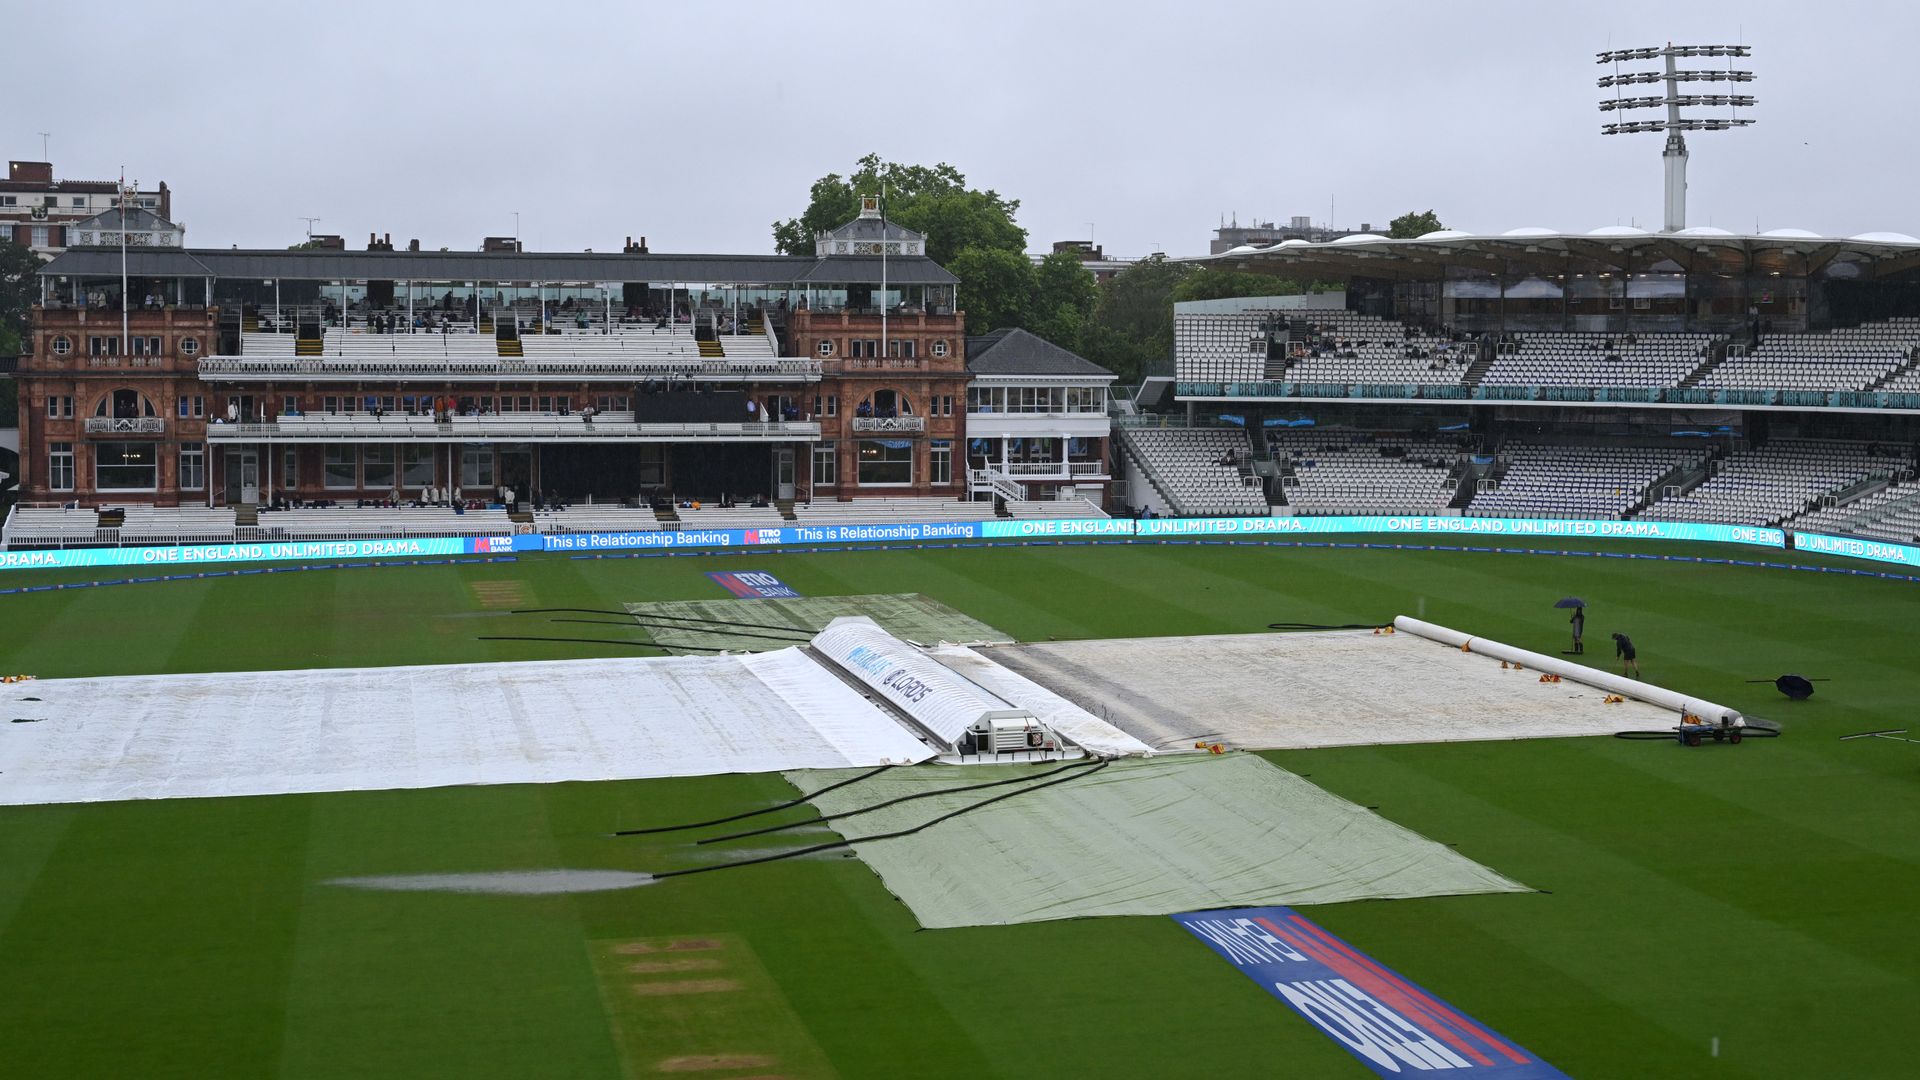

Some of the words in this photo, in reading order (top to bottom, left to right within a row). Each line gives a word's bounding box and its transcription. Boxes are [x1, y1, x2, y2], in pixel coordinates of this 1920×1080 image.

[1176, 382, 1221, 396] BREWDOG
[1238, 383, 1282, 397] BREWDOG
[1301, 383, 1344, 397] BREWDOG
[1361, 385, 1406, 398] BREWDOG
[1423, 385, 1467, 399] BREWDOG
[1485, 386, 1528, 400] BREWDOG
[1726, 390, 1766, 404] BREWDOG
[1783, 391, 1824, 406] BREWDOG
[795, 528, 823, 540] This
[826, 527, 837, 540] is
[841, 524, 920, 539] Relationship
[923, 524, 973, 537] Banking
[1022, 520, 1056, 534] ONE
[1062, 520, 1146, 534] ENGLAND.
[1151, 519, 1238, 533] UNLIMITED
[1243, 519, 1307, 532] DRAMA.
[1387, 518, 1423, 531] ONE
[1428, 518, 1507, 533] ENGLAND.
[1511, 520, 1596, 535] UNLIMITED
[1602, 522, 1665, 536] DRAMA.
[544, 535, 573, 548] This
[576, 535, 587, 547] is
[591, 531, 673, 547] Relationship
[677, 531, 730, 545] Banking
[744, 529, 781, 545] METRO
[1732, 528, 1757, 542] ONE
[143, 549, 178, 562] ONE
[184, 546, 266, 561] ENGLAND.
[270, 543, 357, 557] UNLIMITED
[362, 542, 426, 555] DRAMA.
[474, 537, 513, 553] METRO
[490, 545, 513, 553] BANK
[1810, 536, 1864, 555] UNLIMITED
[1867, 545, 1907, 561] DRAMA.
[755, 587, 799, 597] BANK
